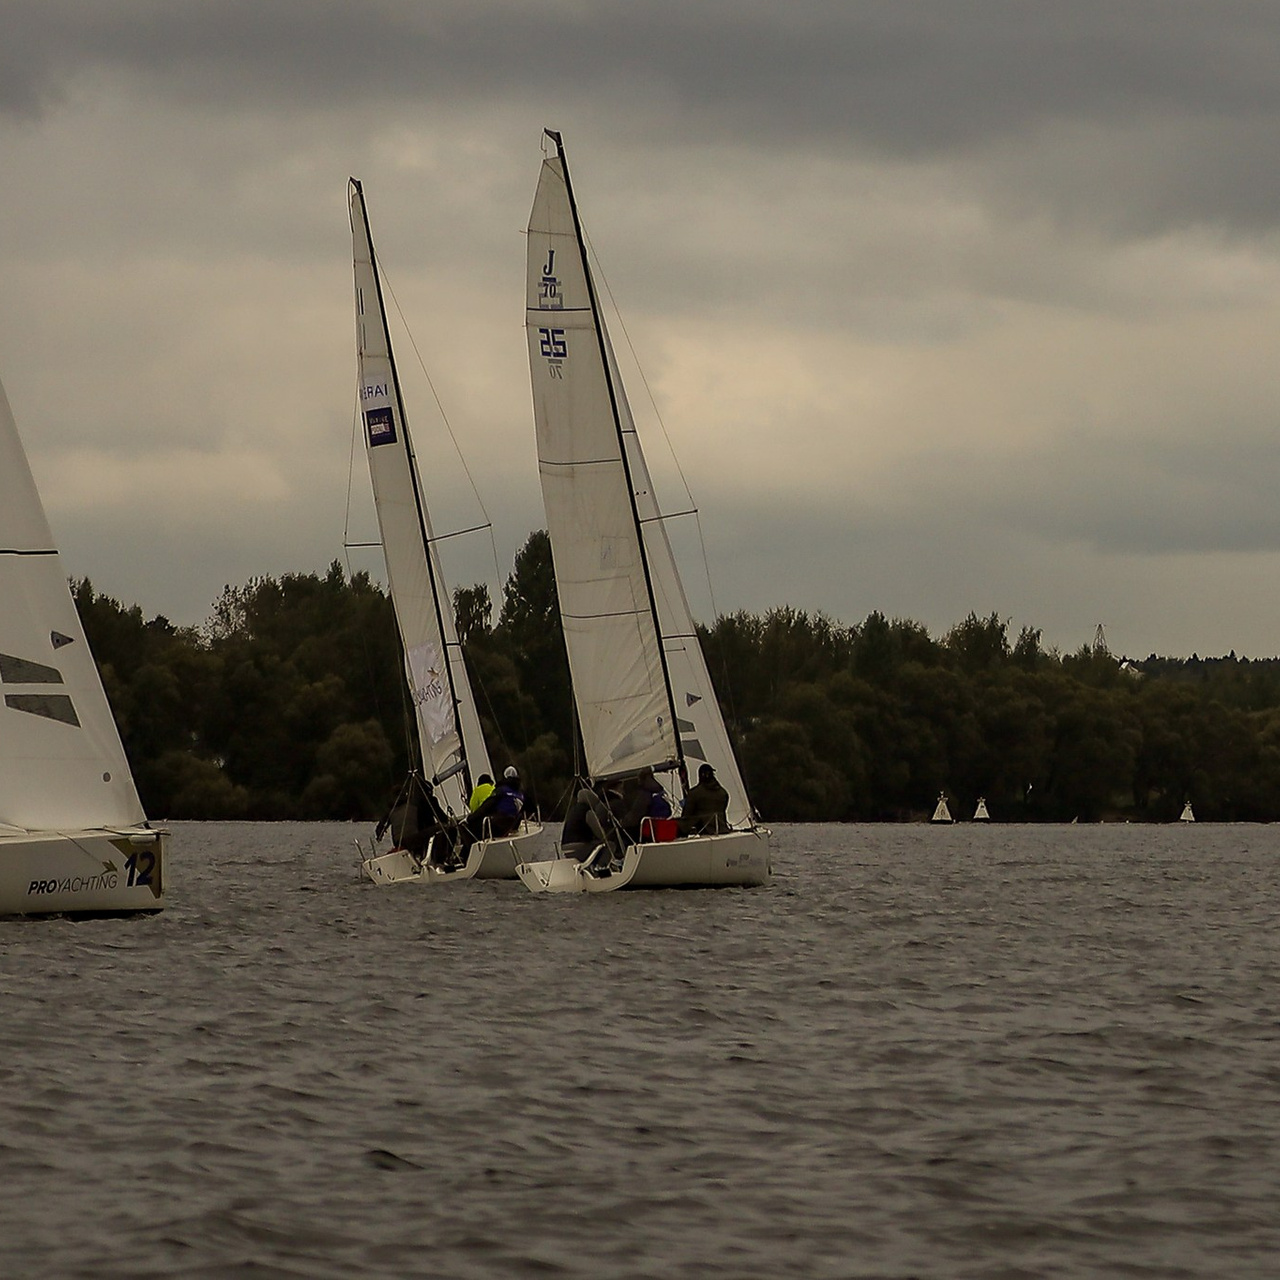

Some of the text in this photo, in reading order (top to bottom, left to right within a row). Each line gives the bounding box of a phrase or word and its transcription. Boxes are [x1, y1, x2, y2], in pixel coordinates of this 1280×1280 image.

[542, 249, 555, 276] J
[544, 283, 556, 298] 70
[539, 328, 568, 358] 25
[124, 851, 155, 888] 12
[27, 873, 118, 896] PROYACHTING
